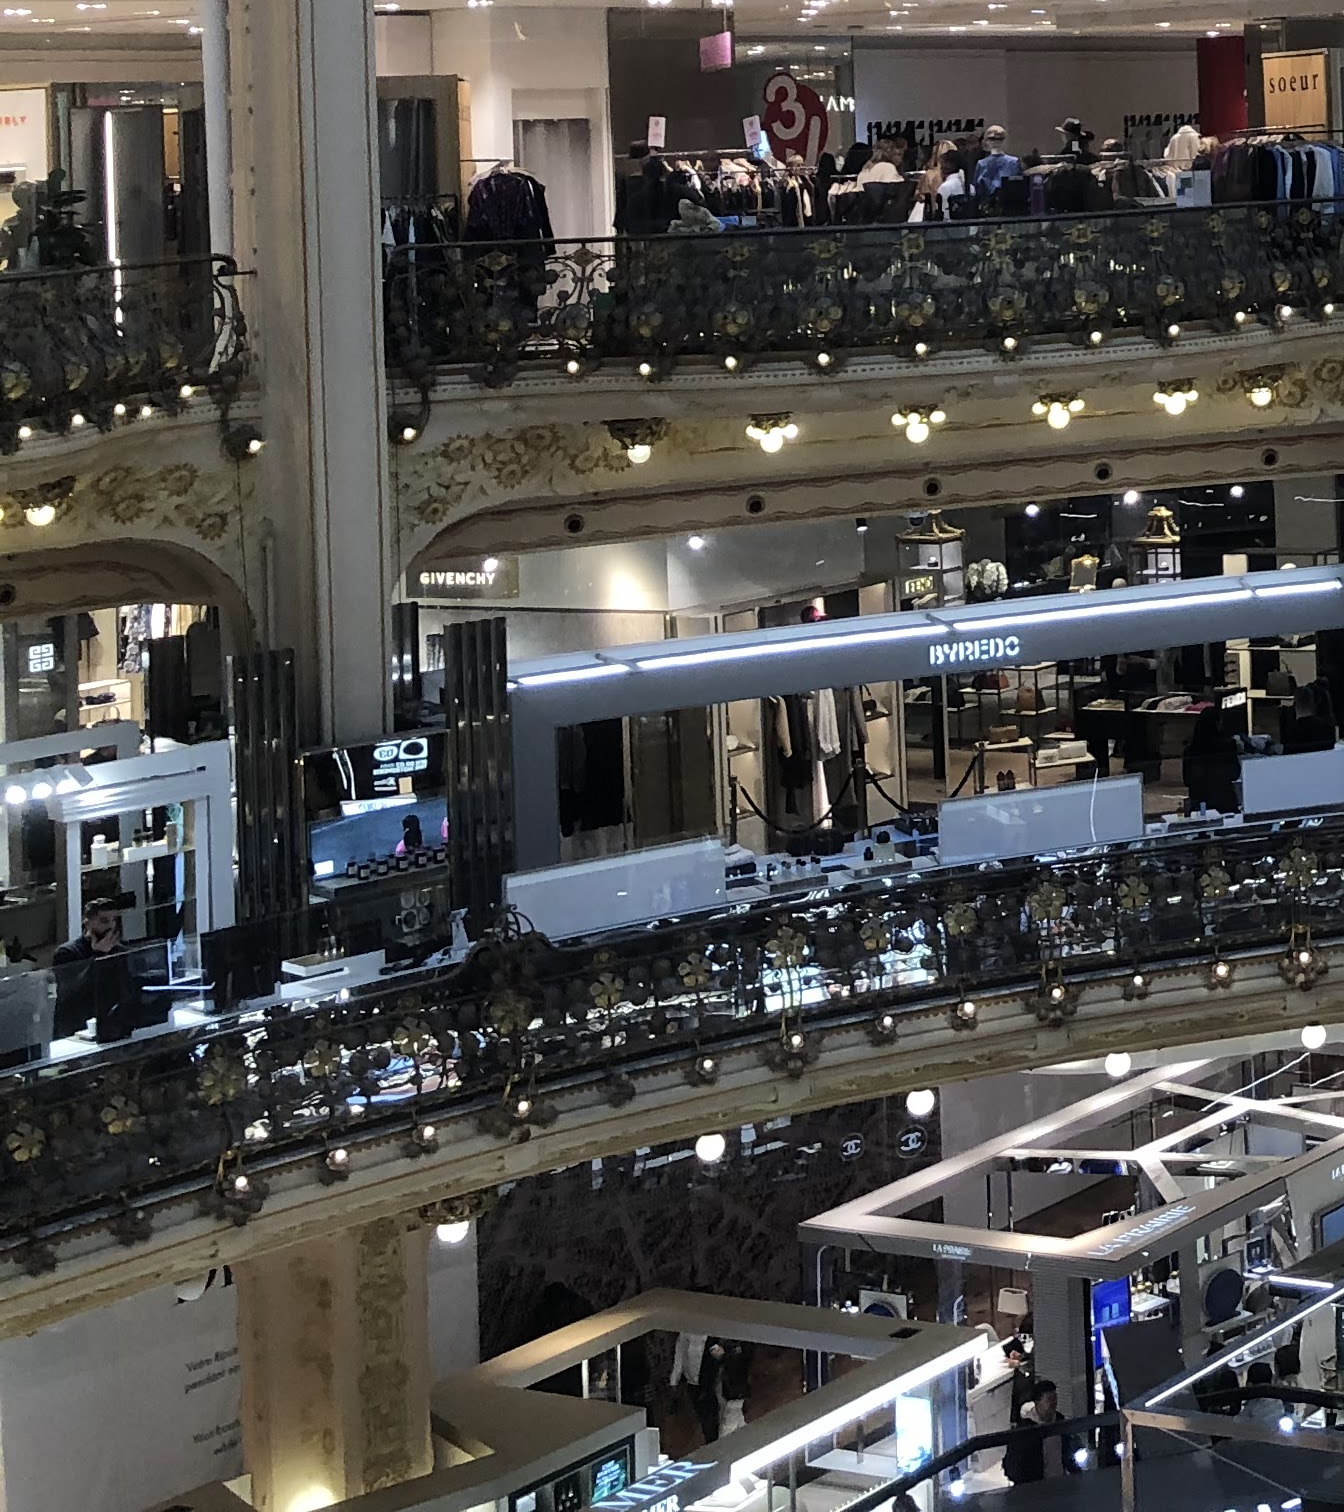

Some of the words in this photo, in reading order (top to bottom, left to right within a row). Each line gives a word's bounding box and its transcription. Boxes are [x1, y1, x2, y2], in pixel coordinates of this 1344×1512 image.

[1269, 73, 1319, 94] soeur
[419, 571, 496, 585] GIVENCHY
[929, 635, 1020, 665] BYREDO
